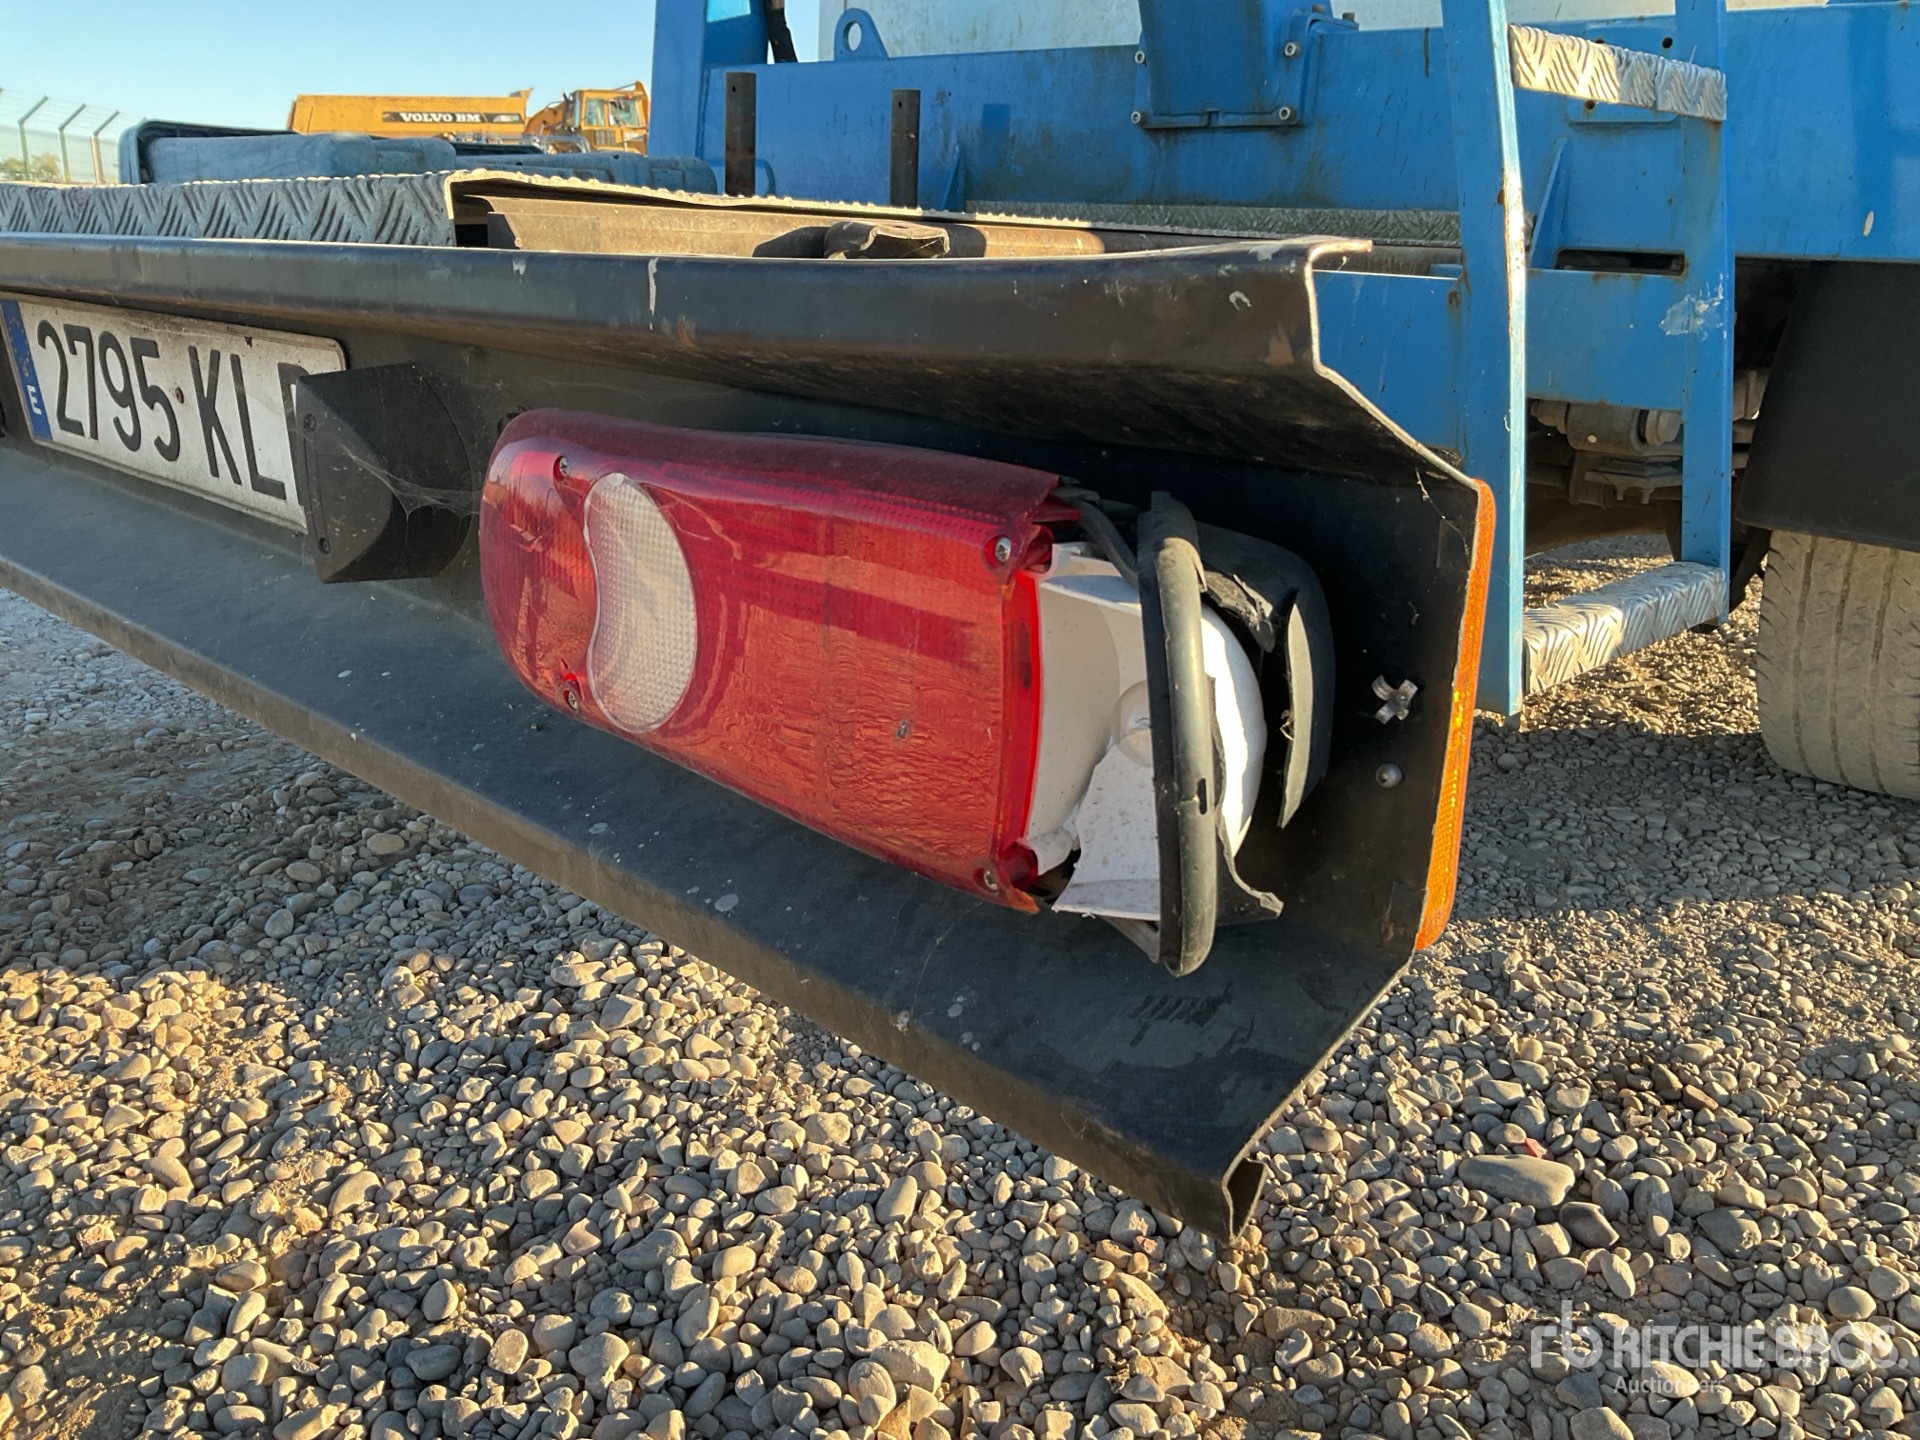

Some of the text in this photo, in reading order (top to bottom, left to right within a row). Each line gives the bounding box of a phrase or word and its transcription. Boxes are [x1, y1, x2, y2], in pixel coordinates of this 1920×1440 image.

[399, 112, 481, 123] VOLVO BM
[27, 385, 42, 415] E
[37, 319, 181, 462] 2795
